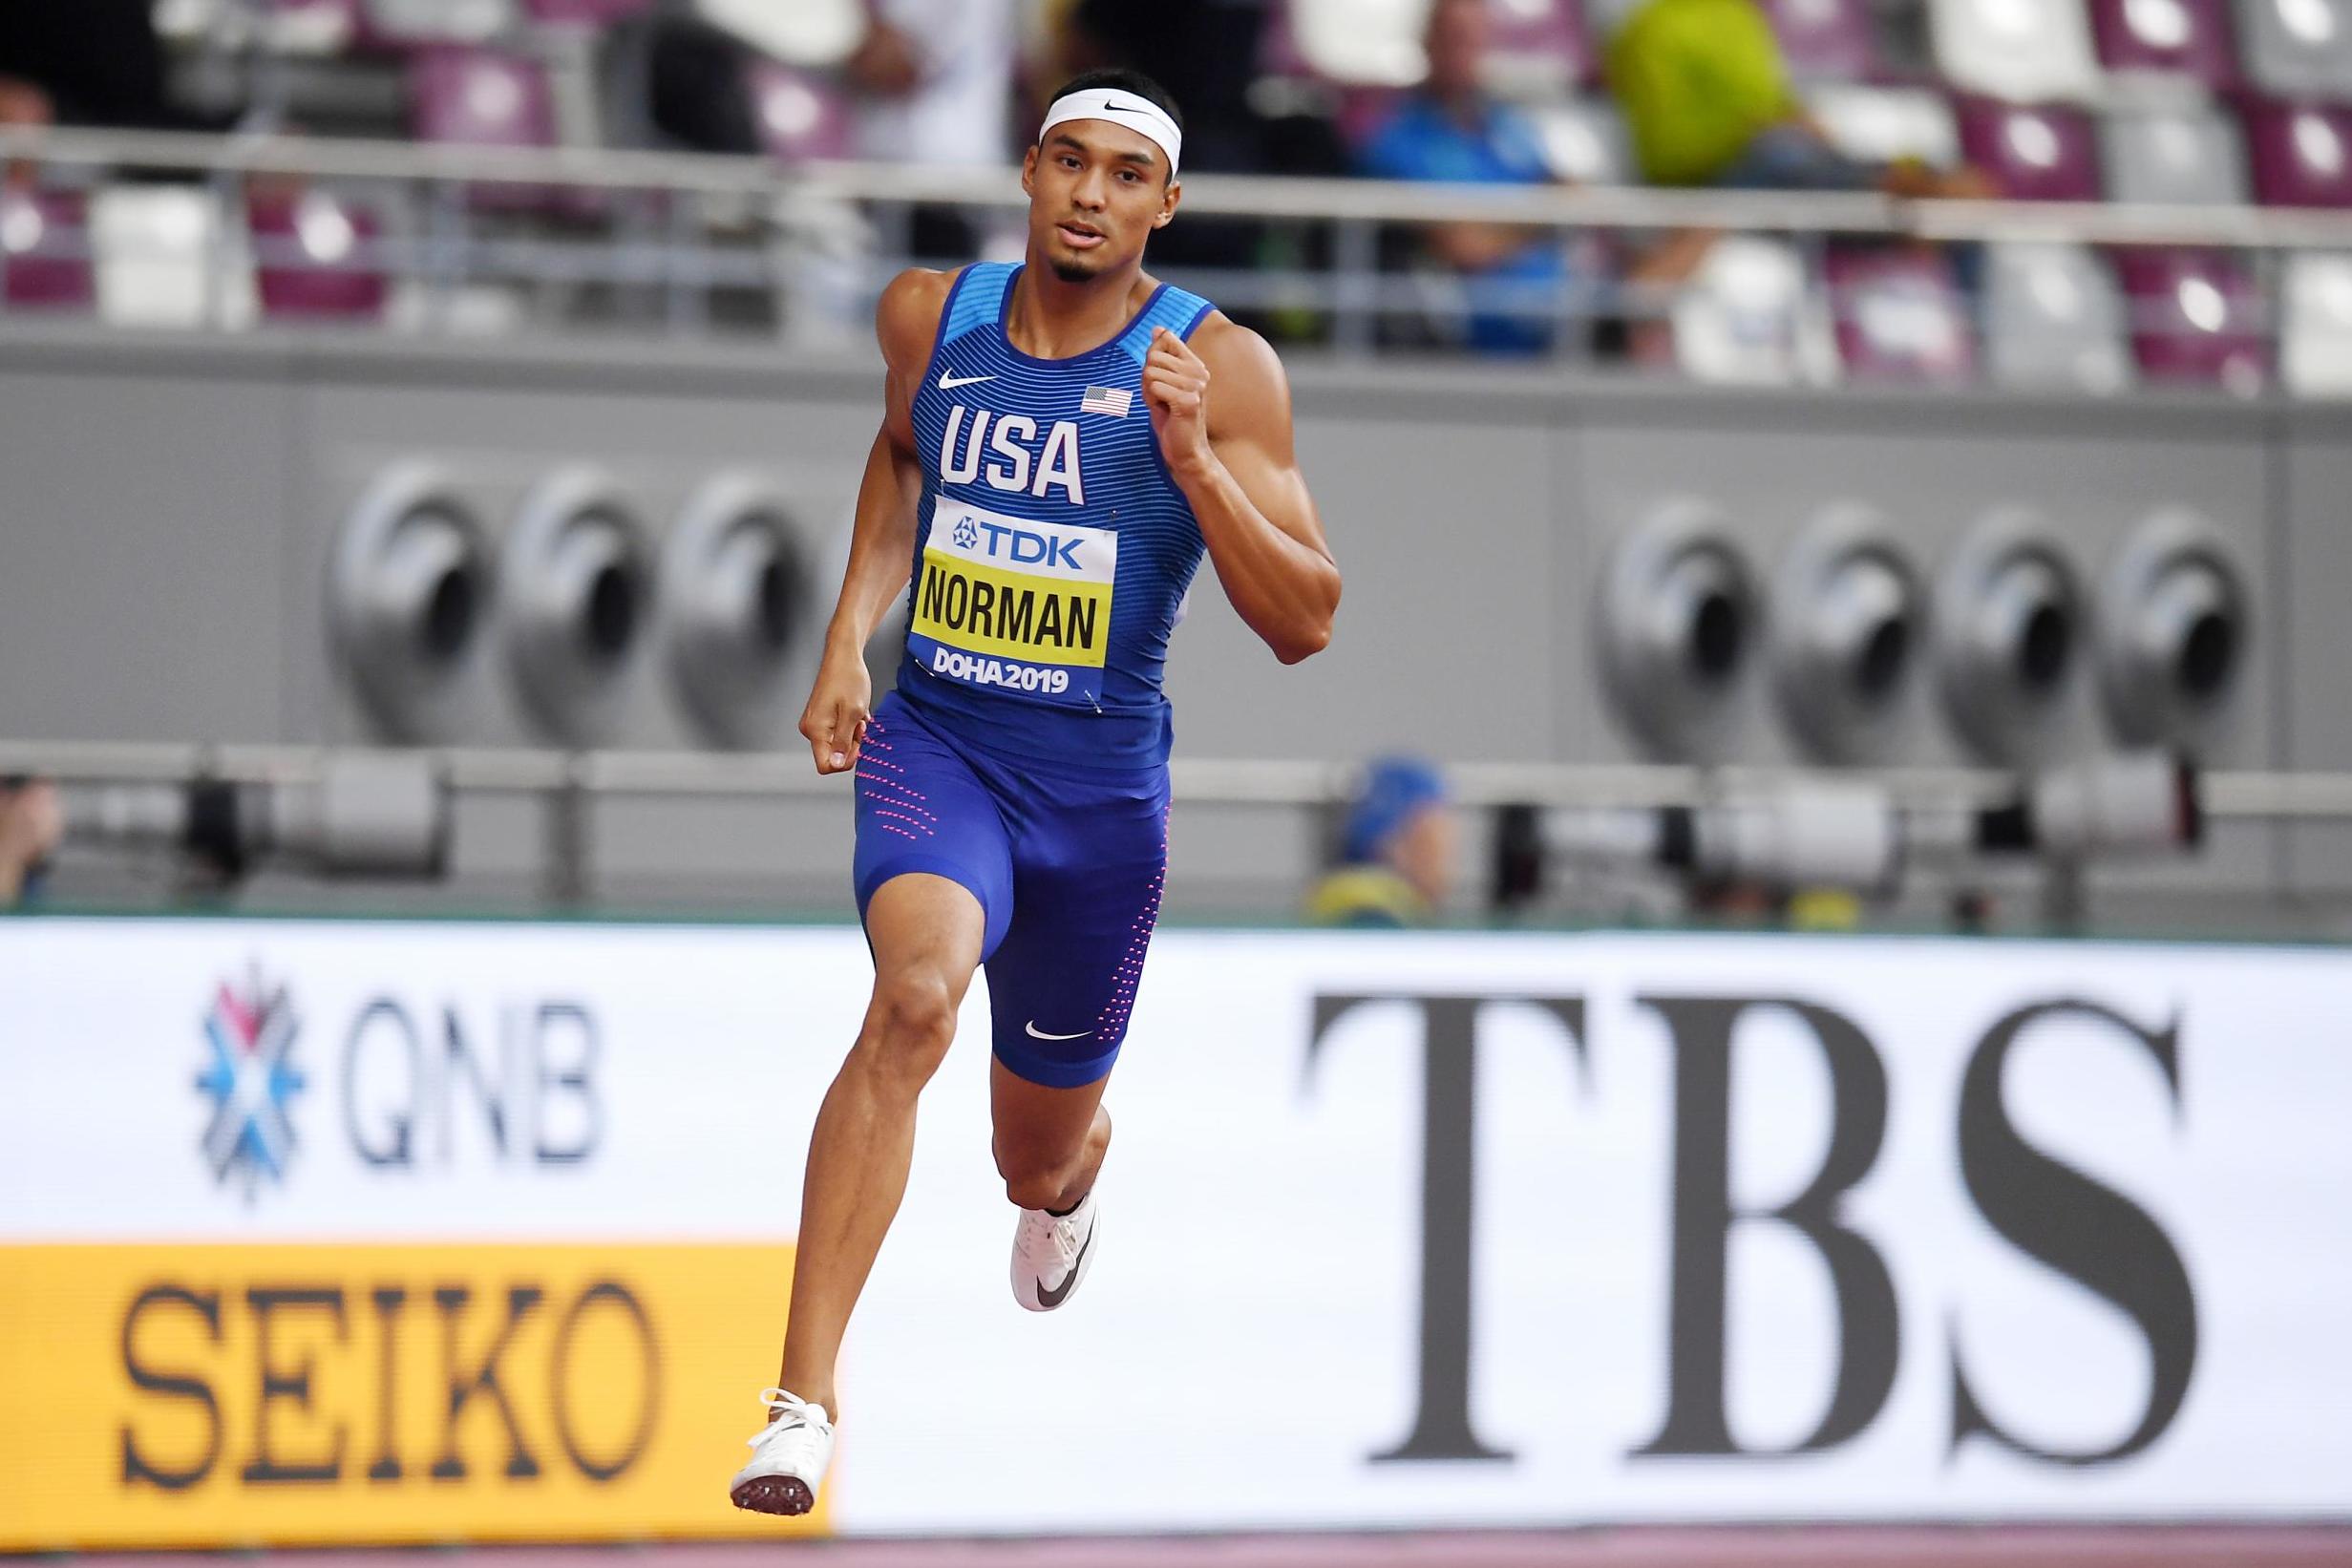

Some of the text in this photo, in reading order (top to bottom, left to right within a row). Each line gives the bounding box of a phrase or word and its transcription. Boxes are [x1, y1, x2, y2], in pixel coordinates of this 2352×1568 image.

[940, 404, 1085, 505] USA
[922, 564, 1097, 650] NORMAN
[980, 521, 1086, 570] TDK
[343, 996, 604, 1168] QNB
[1304, 993, 2200, 1468] TBS
[119, 1280, 662, 1490] SEIKO
